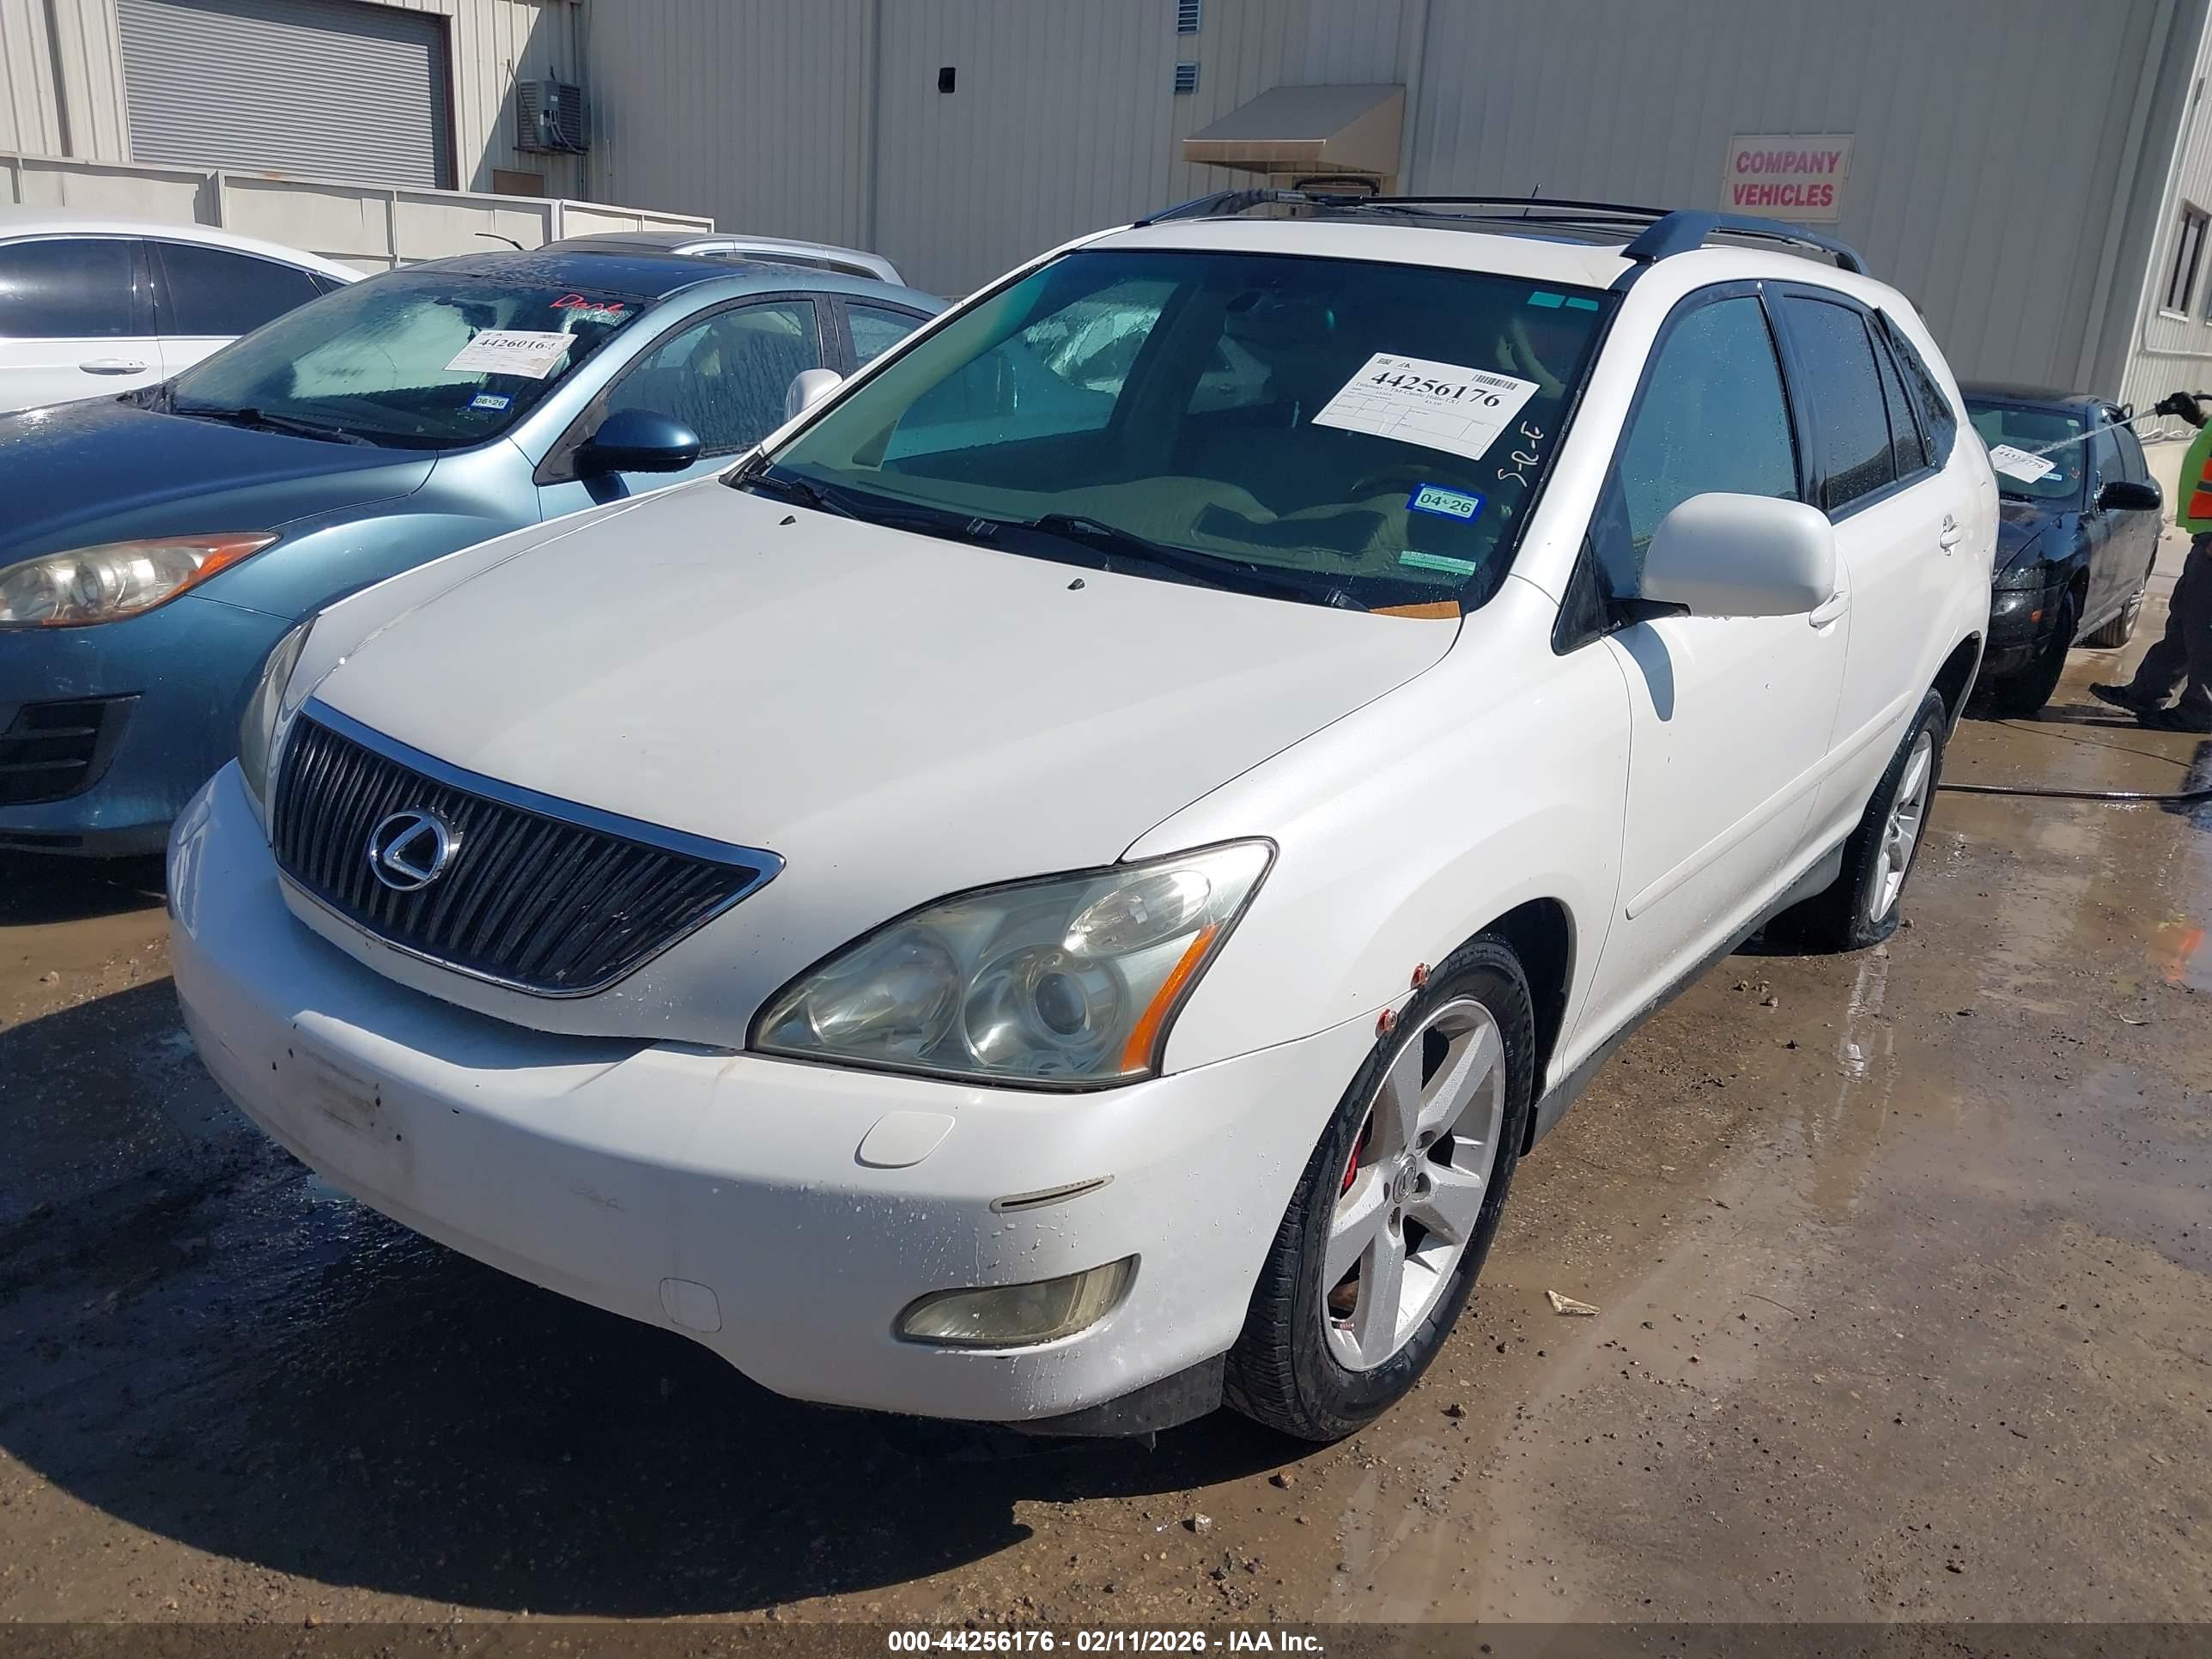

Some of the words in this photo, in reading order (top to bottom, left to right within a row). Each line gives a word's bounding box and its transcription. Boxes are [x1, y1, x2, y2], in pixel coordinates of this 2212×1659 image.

[1736, 151, 1842, 173] COMPANY
[1734, 184, 1834, 206] VEHICLES
[1371, 372, 1505, 407] 44256176
